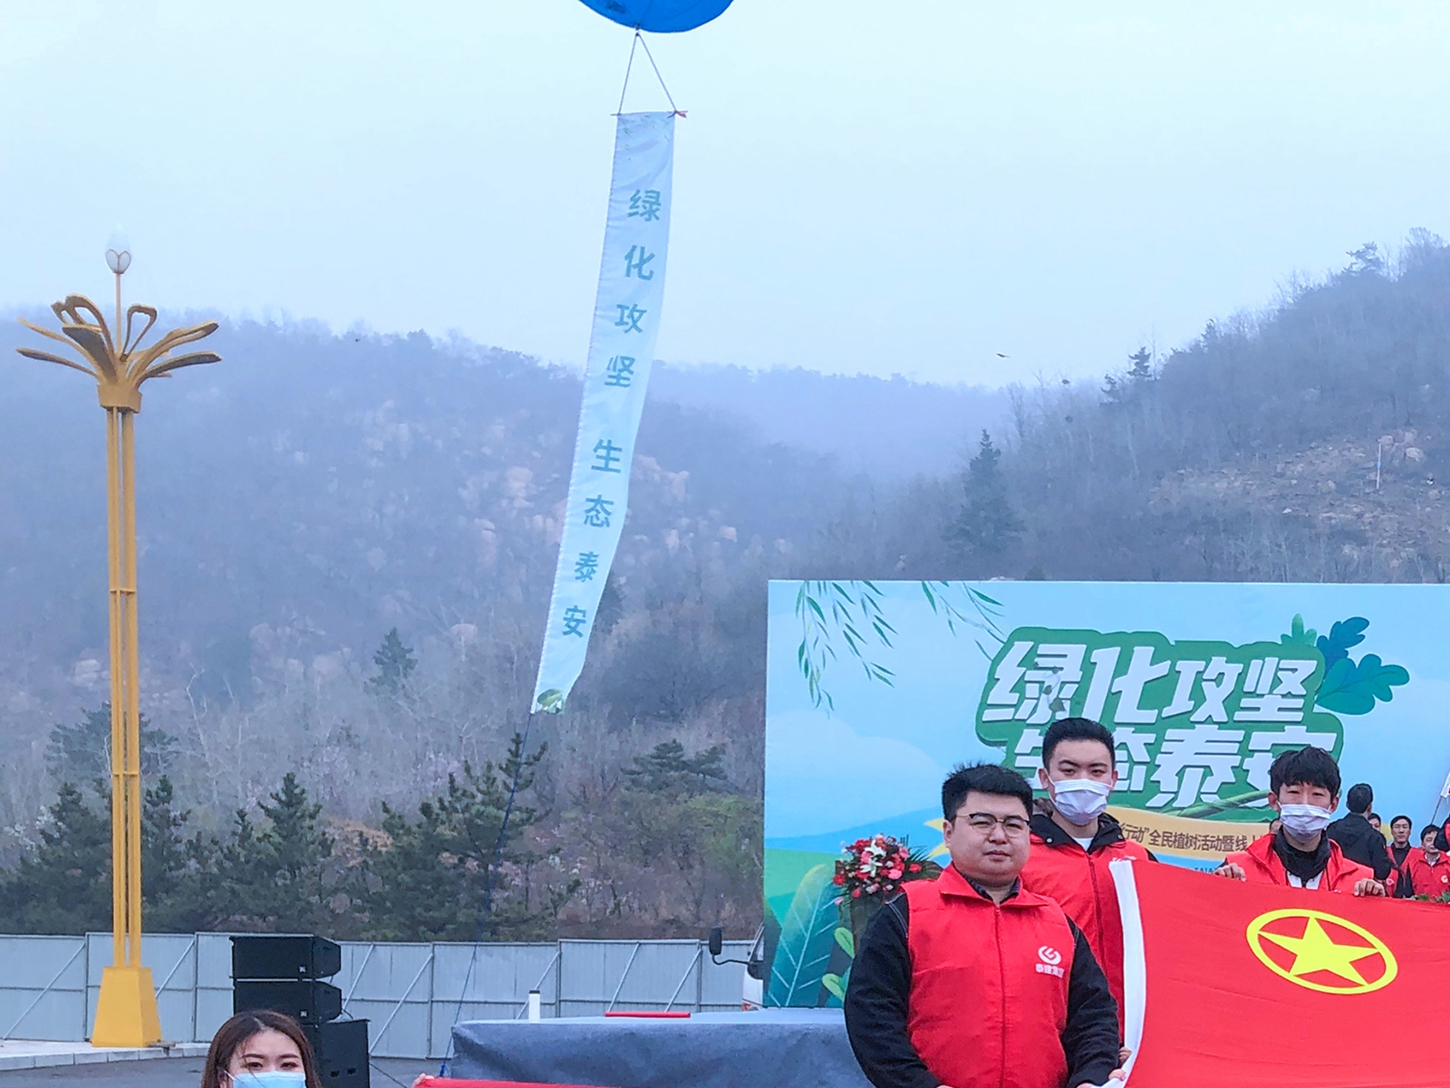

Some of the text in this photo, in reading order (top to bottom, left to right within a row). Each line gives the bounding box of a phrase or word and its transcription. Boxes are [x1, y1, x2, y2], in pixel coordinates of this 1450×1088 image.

[561, 188, 662, 641] 绿化攻坚 生态泰安
[982, 640, 1318, 724] 绿化攻坚
